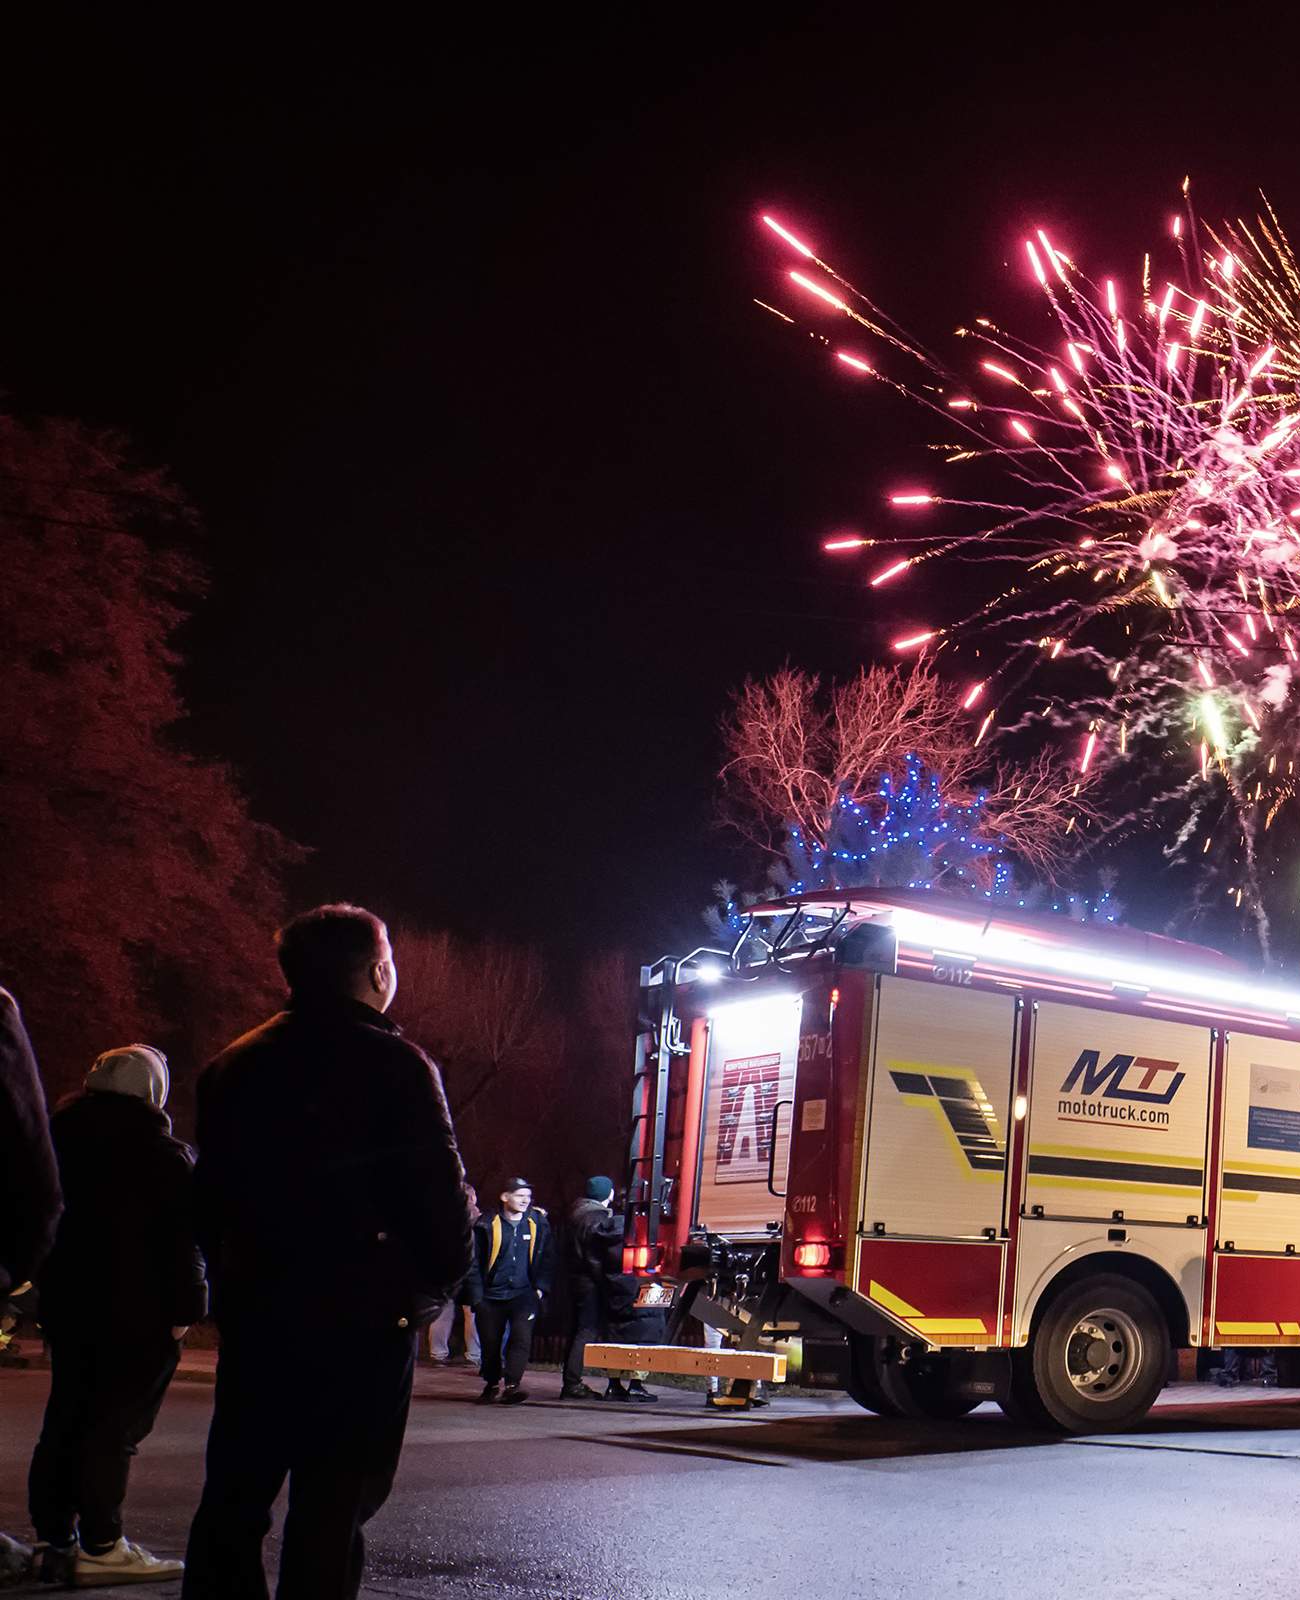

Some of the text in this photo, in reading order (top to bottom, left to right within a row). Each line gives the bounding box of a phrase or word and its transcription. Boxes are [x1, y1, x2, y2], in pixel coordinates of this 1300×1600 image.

[948, 967, 972, 985] 112
[1058, 1099, 1169, 1124] mototruck.com
[800, 1195, 816, 1213] 112
